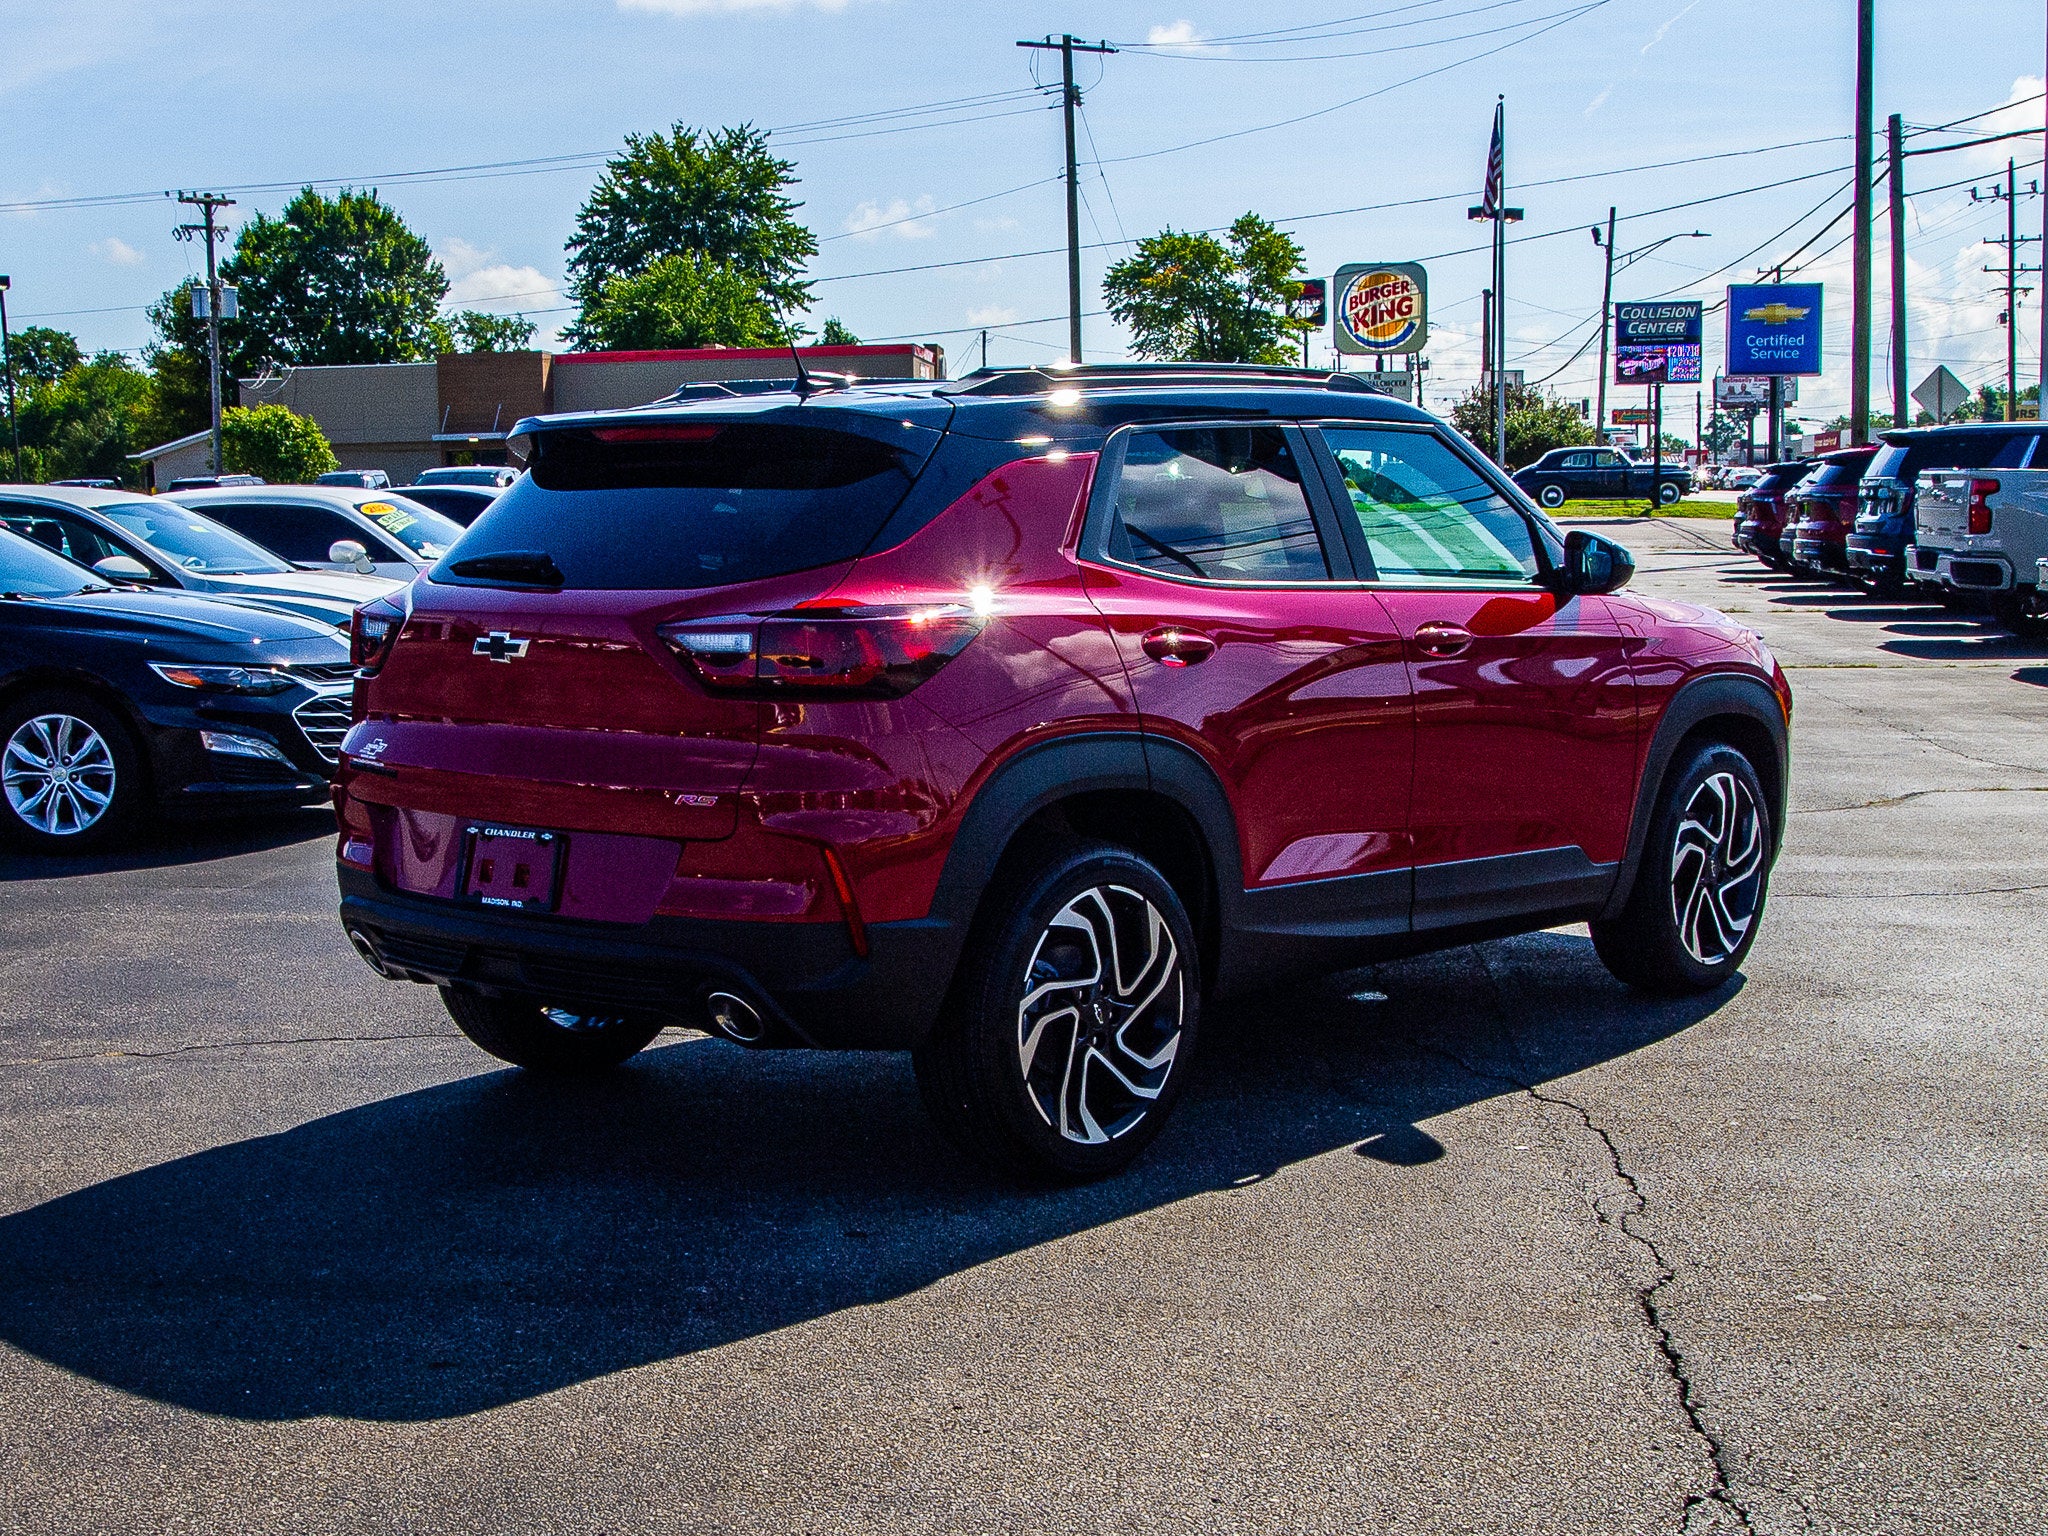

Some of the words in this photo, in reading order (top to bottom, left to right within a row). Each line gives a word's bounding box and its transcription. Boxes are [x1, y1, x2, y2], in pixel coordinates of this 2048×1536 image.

[1349, 280, 1410, 312] BURGER
[1353, 295, 1413, 333] KING
[1620, 306, 1697, 319] COLLISION
[1627, 321, 1686, 334] CENTER
[1746, 334, 1805, 347] Certified
[1750, 347, 1800, 359] Service
[675, 795, 718, 806] RS
[485, 828, 536, 839] CHANDLER
